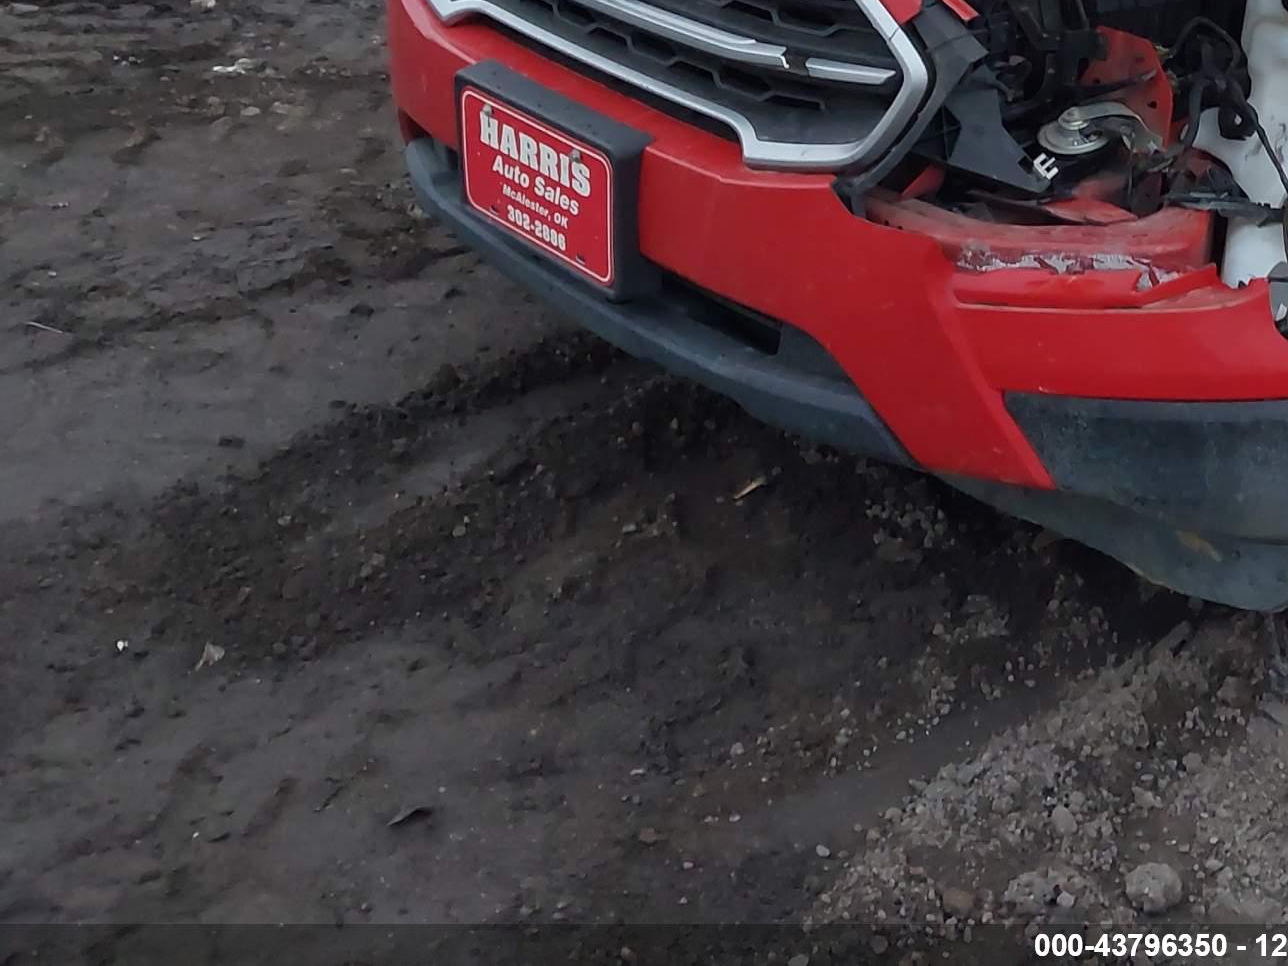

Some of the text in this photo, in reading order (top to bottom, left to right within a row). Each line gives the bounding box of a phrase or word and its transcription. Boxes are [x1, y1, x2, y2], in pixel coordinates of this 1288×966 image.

[480, 109, 591, 198] HARRIS
[492, 155, 579, 216] Auto Sales
[553, 212, 569, 230] OK
